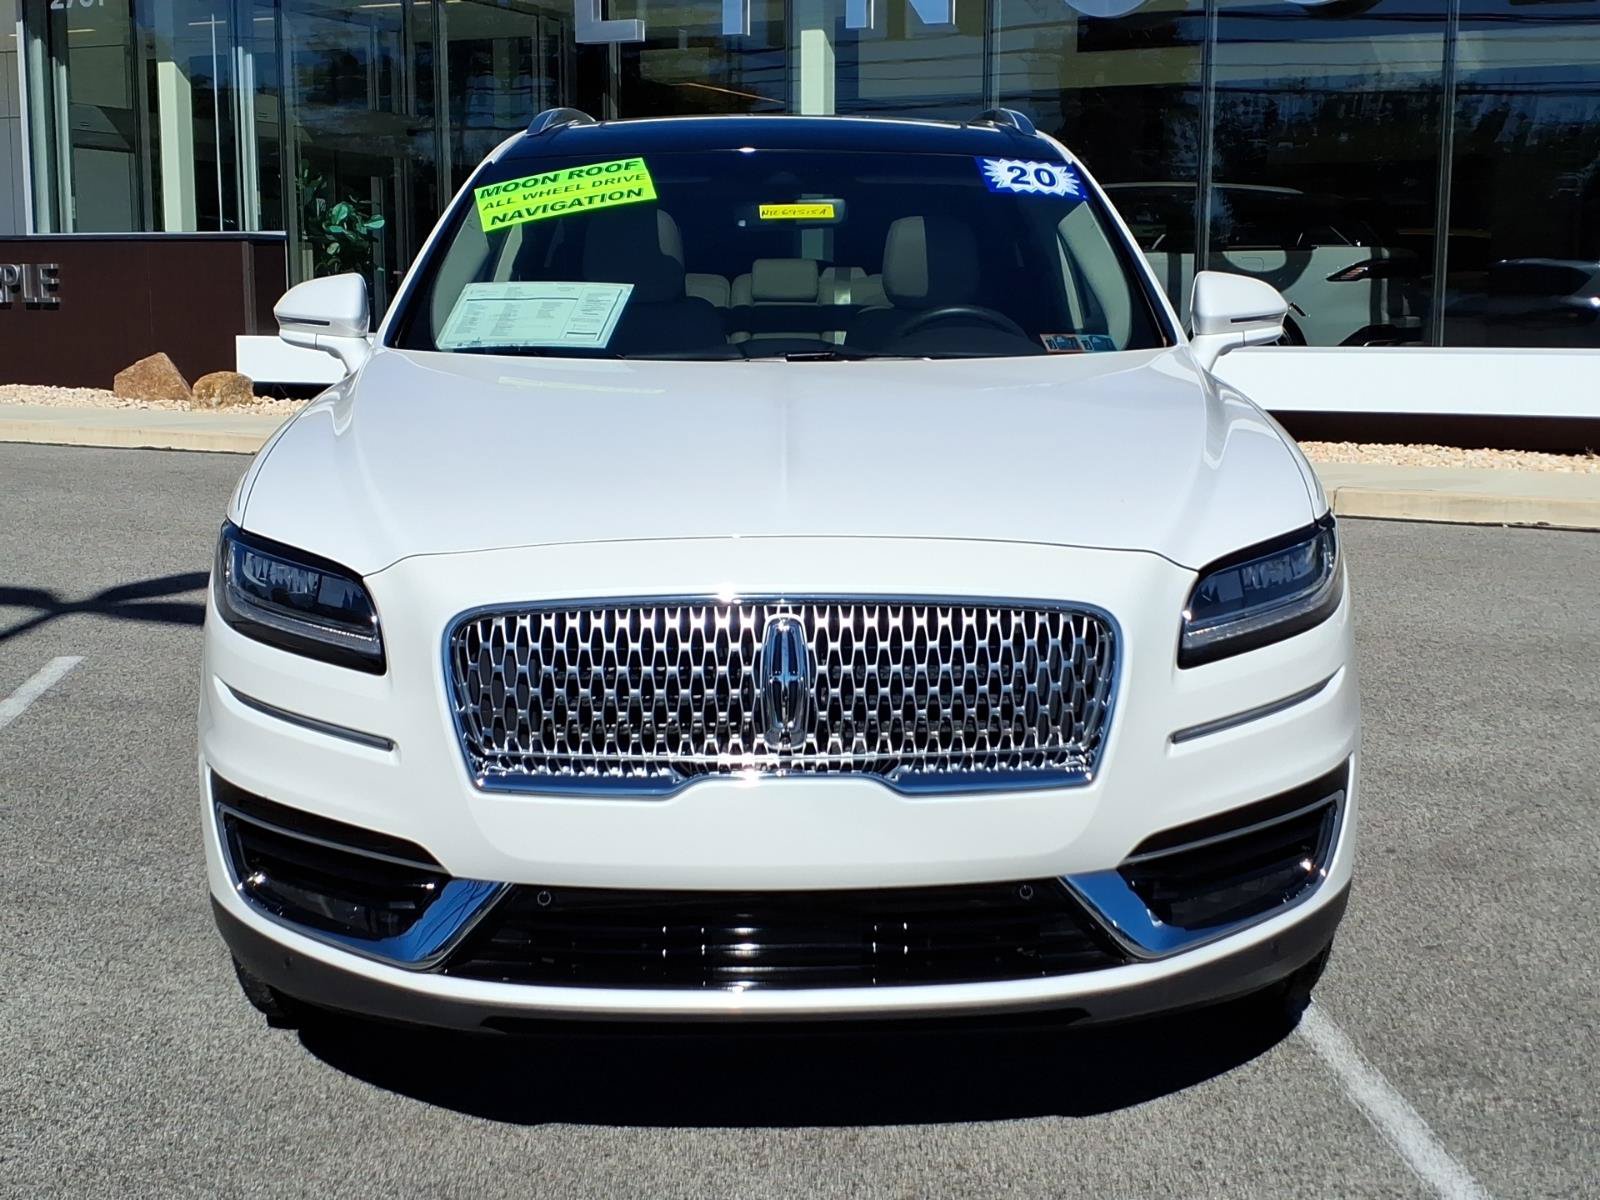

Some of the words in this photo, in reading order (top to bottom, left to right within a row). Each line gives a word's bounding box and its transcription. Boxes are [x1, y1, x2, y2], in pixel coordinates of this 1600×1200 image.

[480, 173, 560, 199] MOON
[567, 160, 641, 180] ROOF
[482, 197, 516, 211] ALL
[522, 183, 585, 201] WHEEL
[591, 173, 647, 188] DRIVE
[1007, 165, 1056, 188] 20
[491, 187, 644, 225] NAVIGATION
[0, 263, 61, 303] PLE
